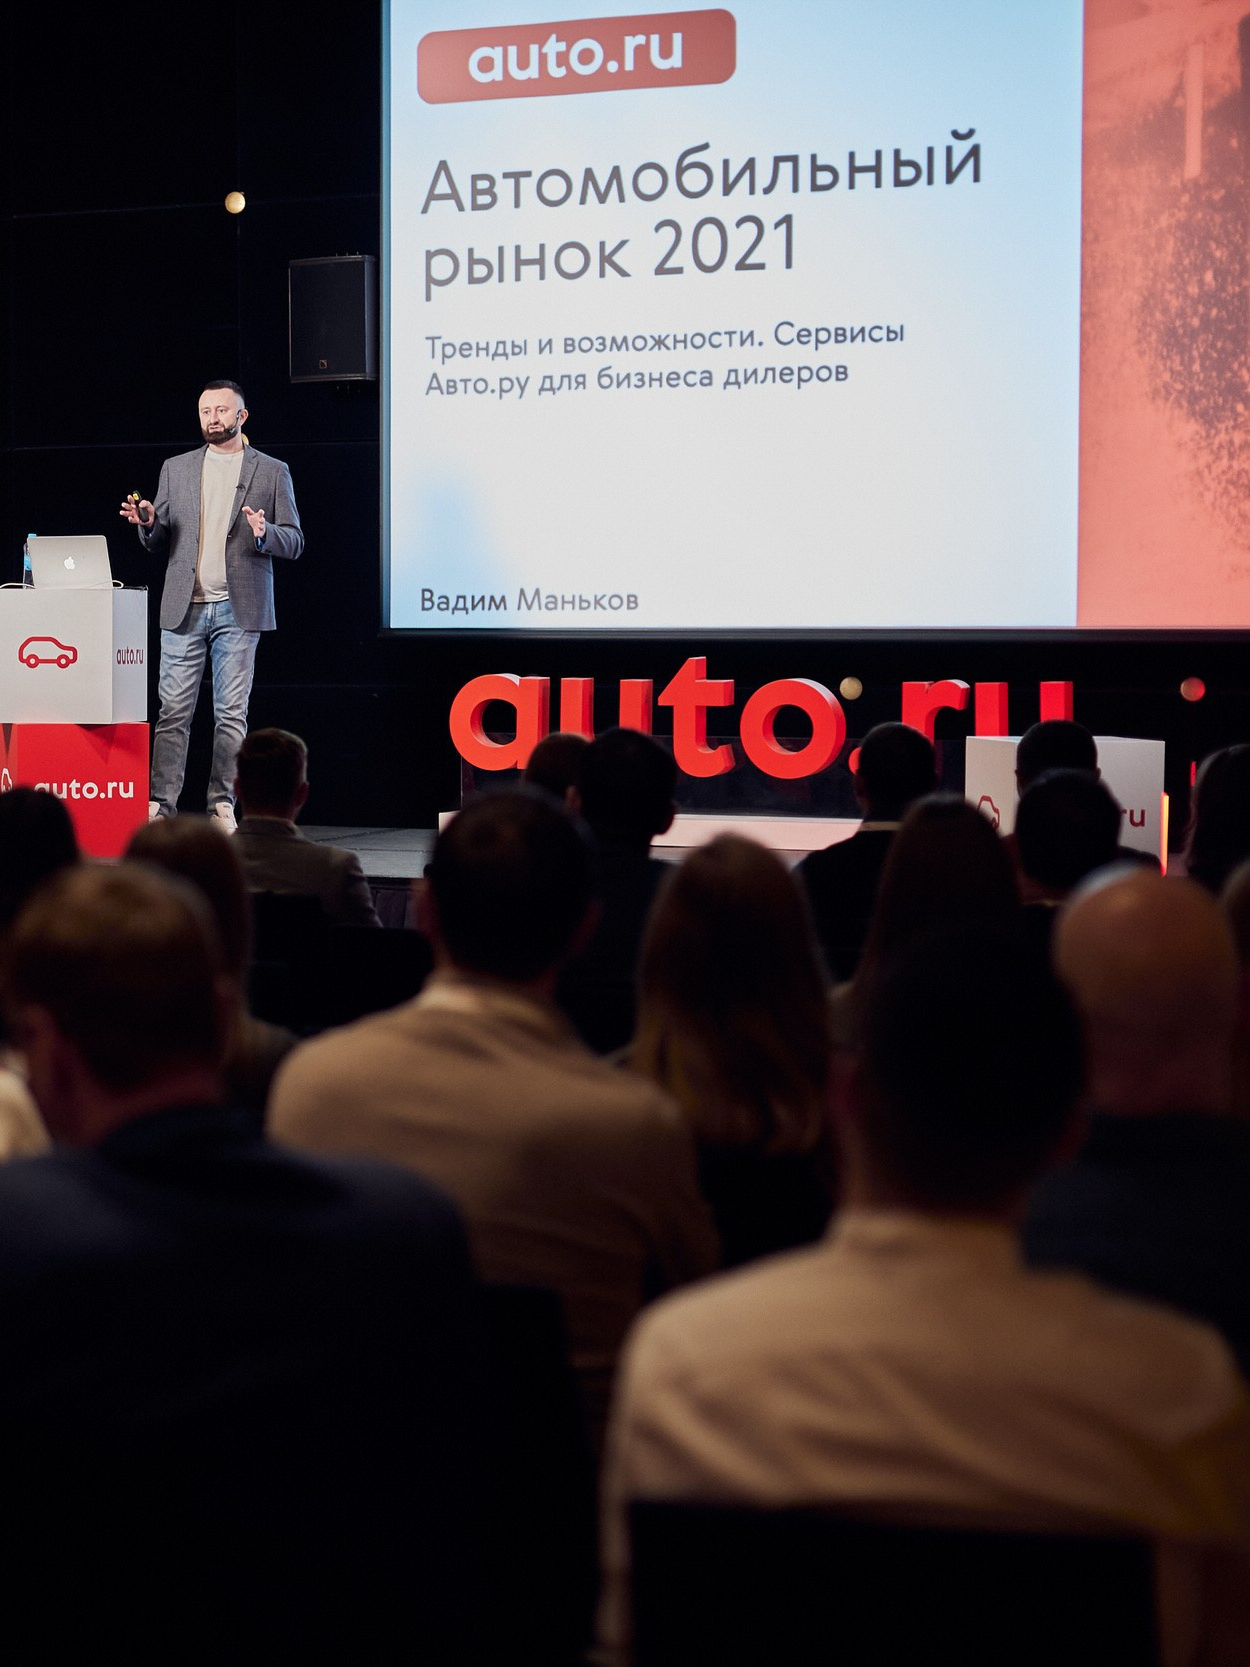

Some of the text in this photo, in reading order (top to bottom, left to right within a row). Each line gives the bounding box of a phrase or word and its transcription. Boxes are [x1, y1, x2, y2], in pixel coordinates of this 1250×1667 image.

[467, 31, 684, 83] auto.ru
[420, 127, 982, 215] Автомобильный
[424, 213, 795, 302] рынок 2021
[425, 321, 905, 364] Тренды и возможности. Сервисы
[425, 362, 849, 400] Авто.ру для бизнеса дилеров
[421, 587, 639, 615] Вадим Маньков
[116, 646, 144, 665] auto.ru
